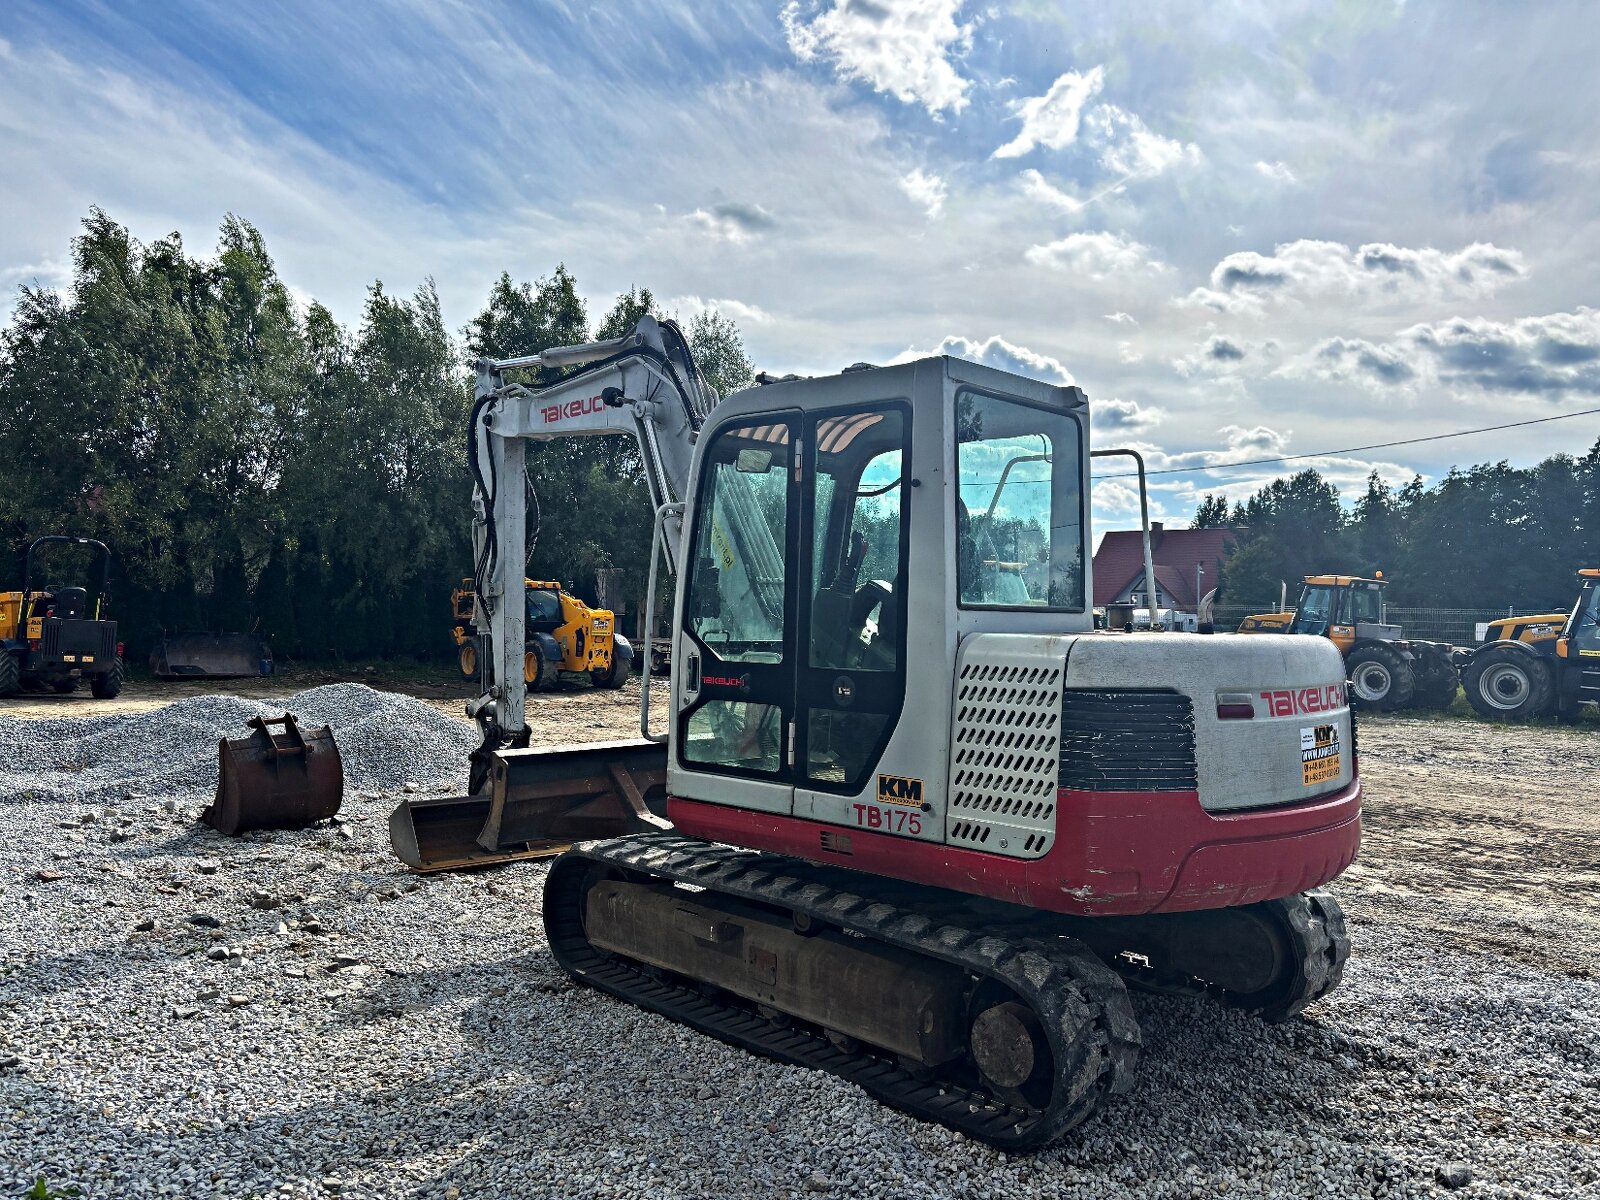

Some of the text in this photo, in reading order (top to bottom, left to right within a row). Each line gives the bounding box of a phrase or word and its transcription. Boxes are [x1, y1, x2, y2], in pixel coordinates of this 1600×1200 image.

[541, 395, 606, 423] TAKEUC
[880, 776, 922, 800] KM
[853, 804, 922, 834] TB175
